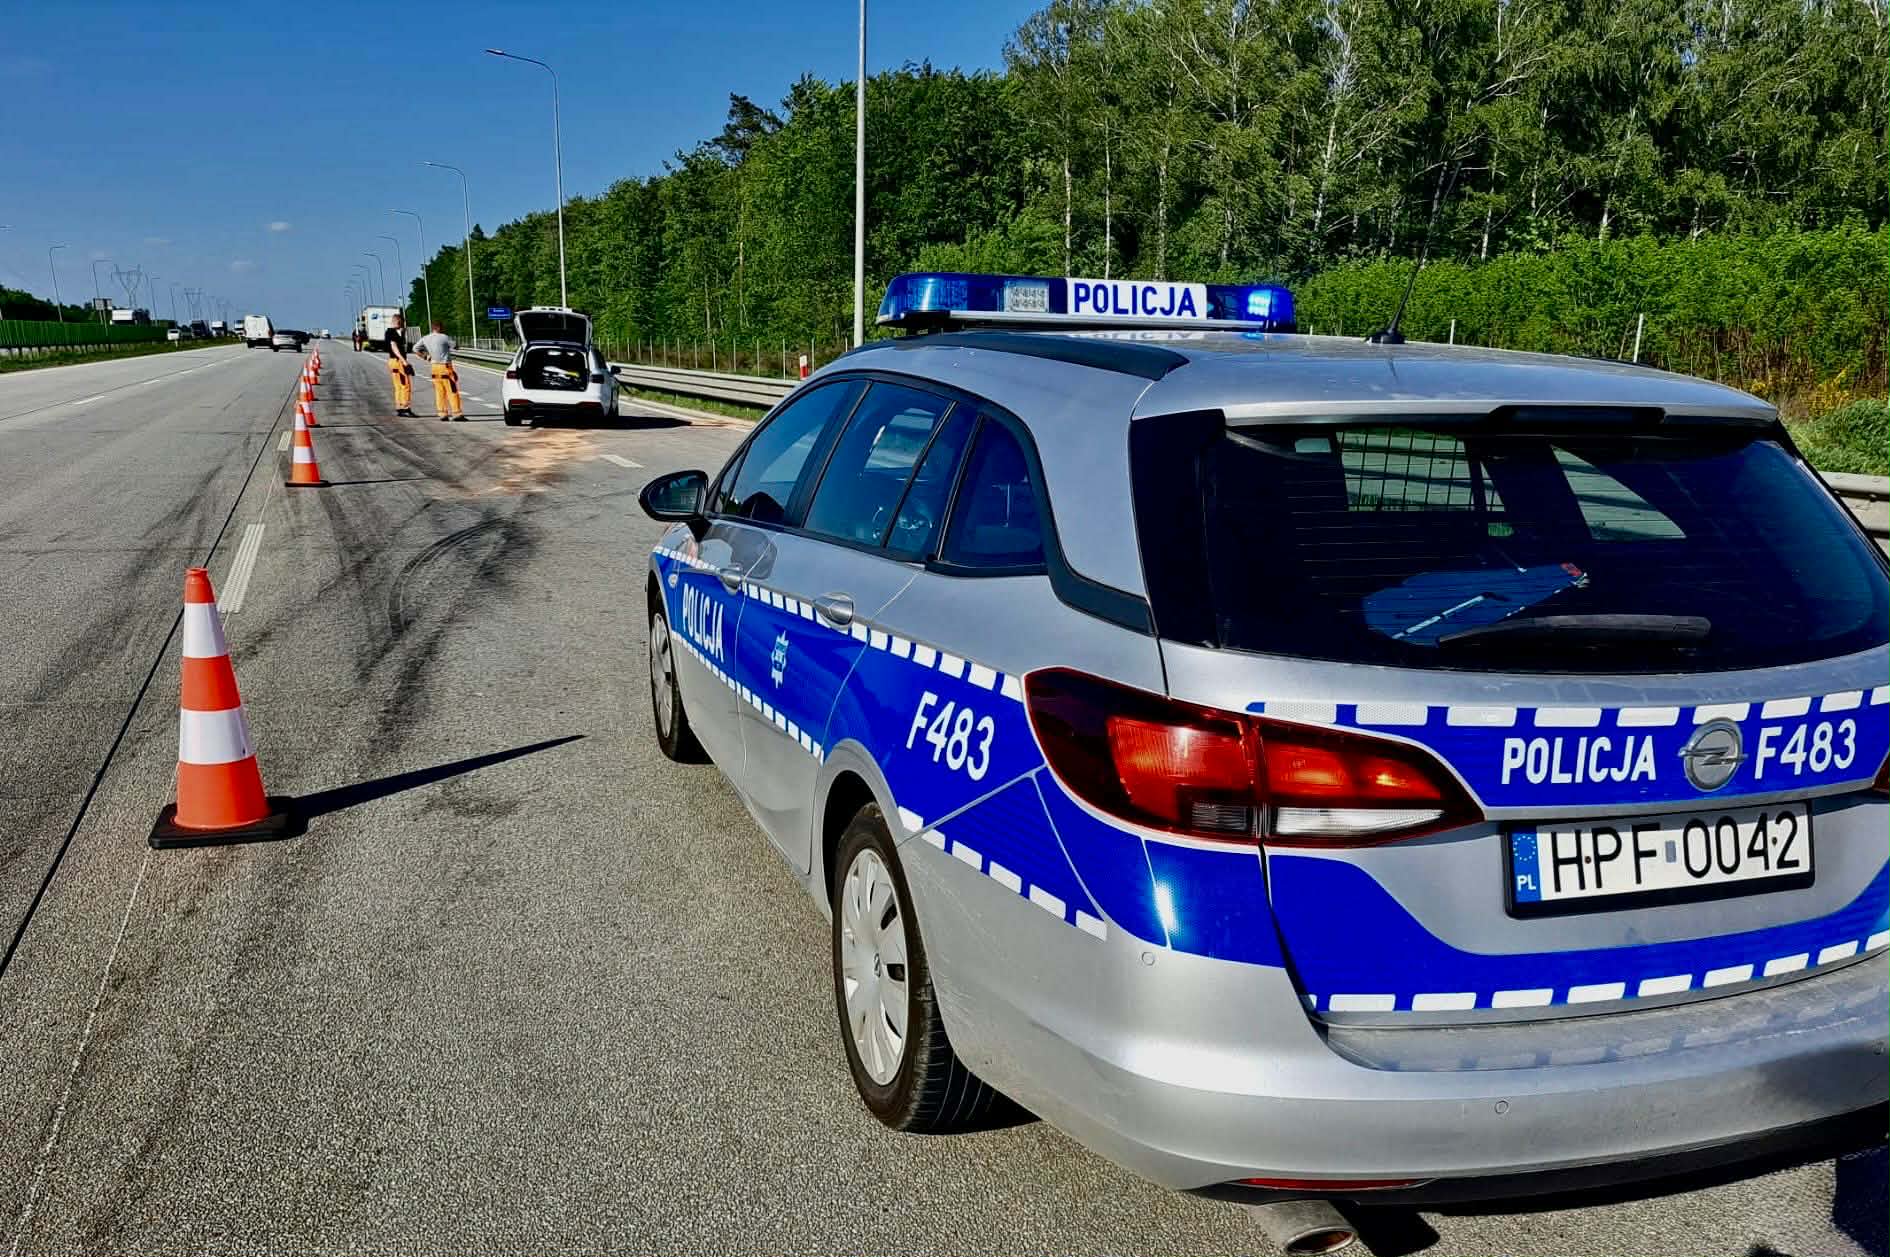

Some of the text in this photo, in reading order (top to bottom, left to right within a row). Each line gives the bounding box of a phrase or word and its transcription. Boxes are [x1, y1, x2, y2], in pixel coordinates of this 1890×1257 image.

[1073, 282, 1197, 318] POLICJA
[682, 583, 725, 662] POLICJA
[906, 691, 995, 781] F483
[1501, 735, 1657, 785] POLICJA
[1754, 718, 1857, 780] F483
[1516, 874, 1537, 891] PL
[1551, 810, 1800, 893] HPF 0042
